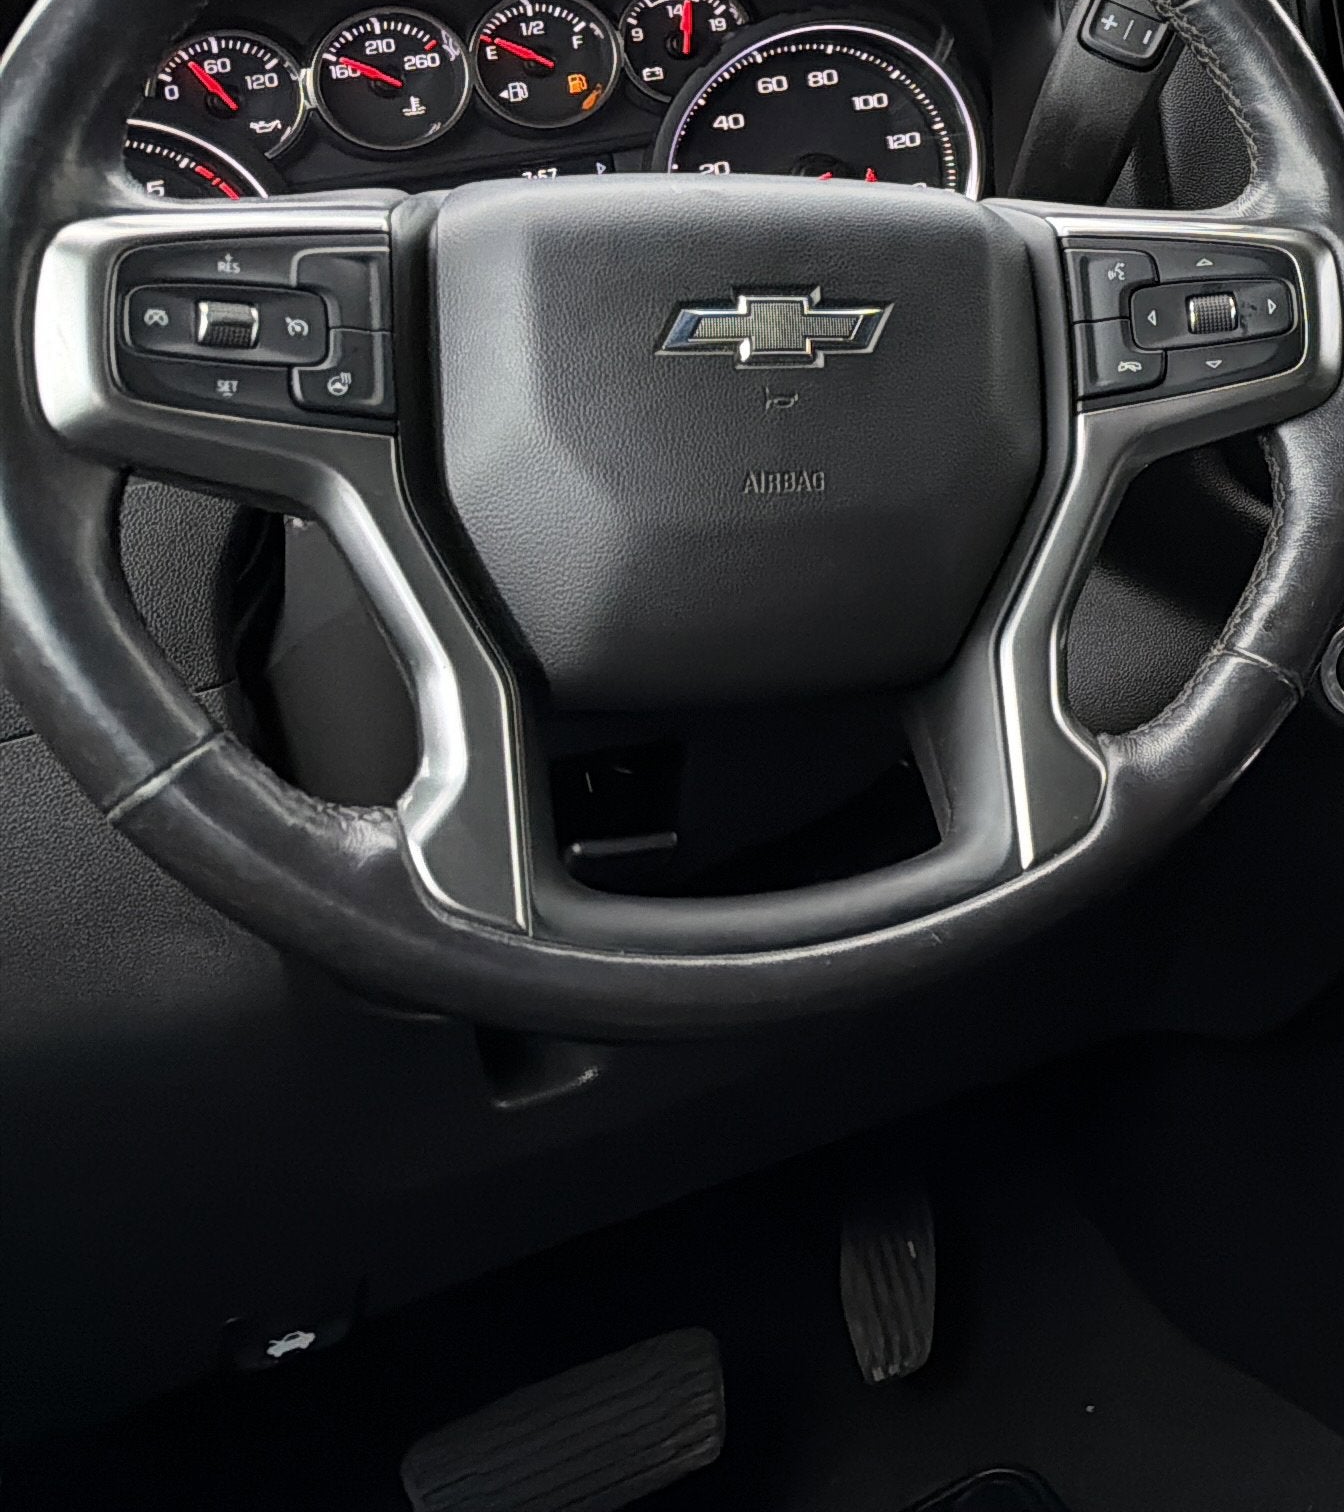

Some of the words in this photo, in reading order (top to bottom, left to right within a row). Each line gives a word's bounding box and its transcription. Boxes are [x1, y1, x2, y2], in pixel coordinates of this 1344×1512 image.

[665, 4, 683, 18] 14
[519, 20, 545, 36] 1/2
[708, 17, 727, 33] 19
[571, 34, 584, 50] F
[631, 26, 644, 42] 9
[364, 38, 396, 56] 210
[485, 44, 499, 61] E
[203, 57, 231, 74] 60
[403, 52, 441, 71] 260
[244, 72, 279, 90] 120
[756, 74, 789, 94] 60
[807, 69, 839, 88] 80
[164, 84, 180, 101] 0
[850, 92, 889, 111] 100
[711, 113, 745, 131] 40
[885, 131, 921, 150] 120
[698, 161, 731, 176] 20
[146, 178, 165, 197] 5
[217, 260, 241, 274] RES
[217, 380, 239, 392] SET
[743, 470, 825, 494] AIRBAG
